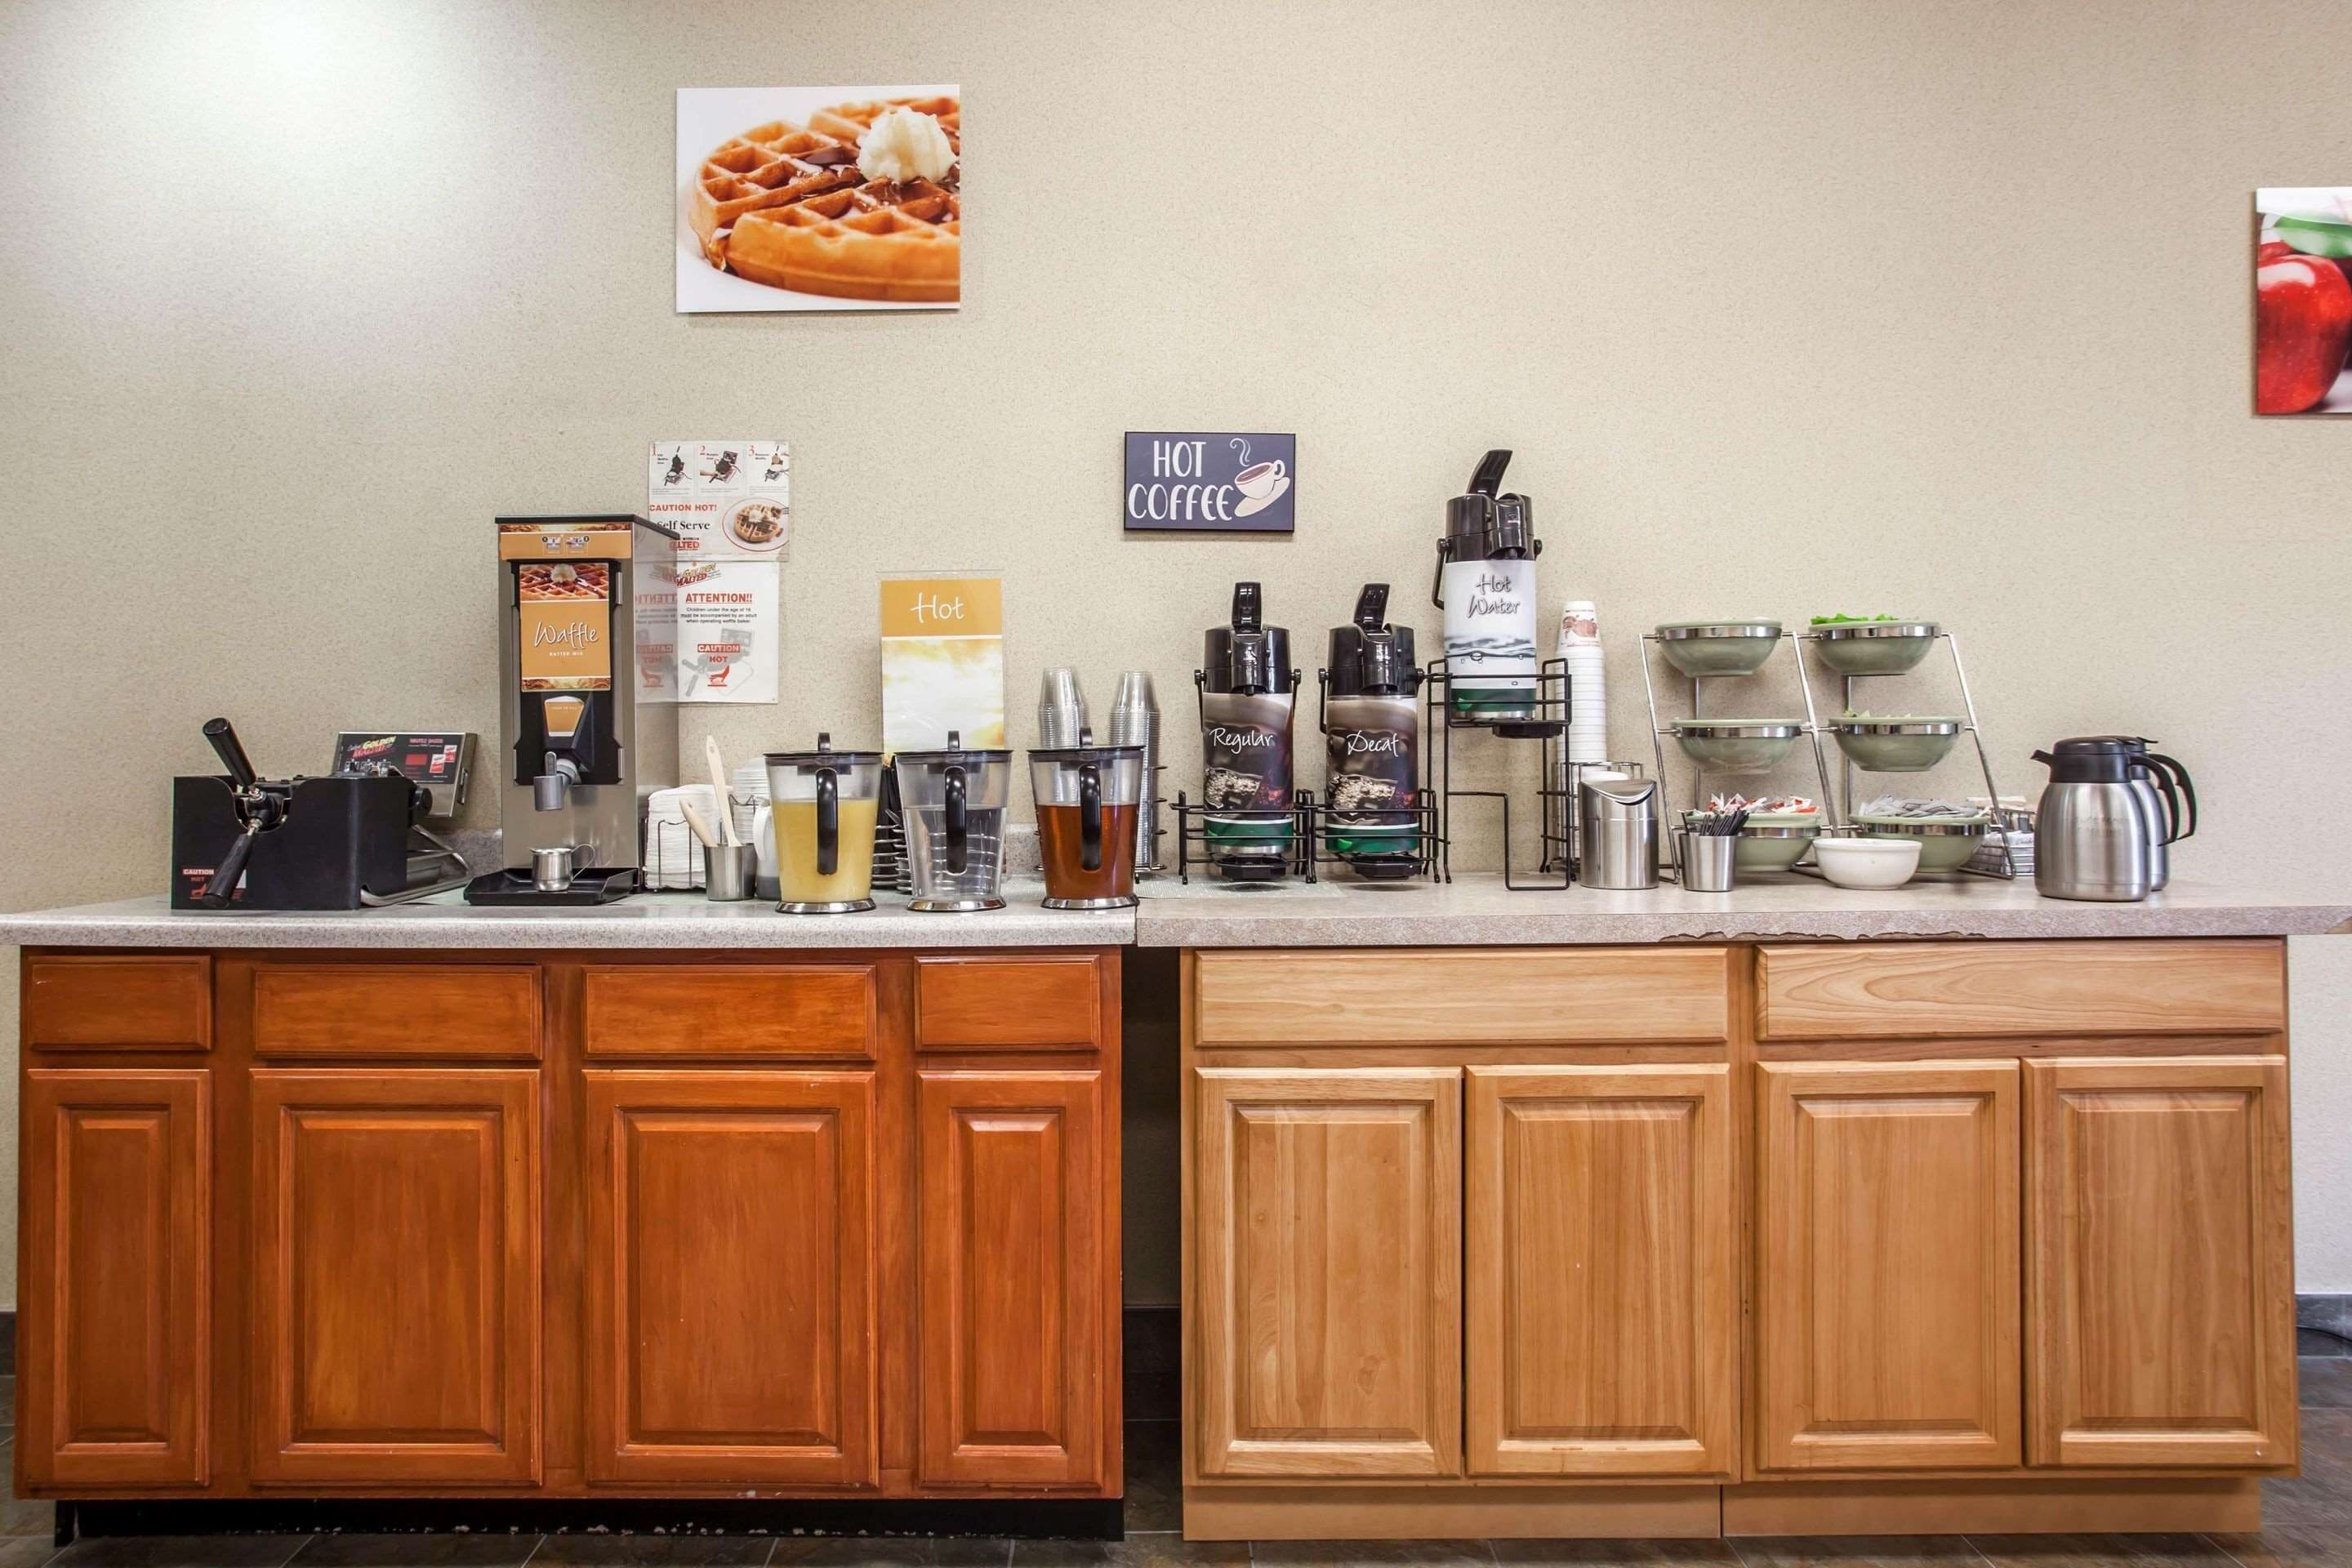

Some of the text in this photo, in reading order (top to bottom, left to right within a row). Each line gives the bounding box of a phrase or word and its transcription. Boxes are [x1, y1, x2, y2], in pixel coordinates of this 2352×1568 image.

[699, 443, 706, 453] 2
[748, 444, 755, 457] 3
[1153, 440, 1206, 477] HOT
[1128, 483, 1234, 520] COFFEE
[679, 521, 710, 530] Serve
[1476, 573, 1512, 595] Hot
[685, 593, 752, 603] ATTENTION!!
[910, 592, 964, 624] Hot
[1468, 595, 1521, 619] Water
[534, 621, 599, 649] Waffle
[1209, 728, 1275, 754] Regular
[1346, 730, 1399, 757] Decaf
